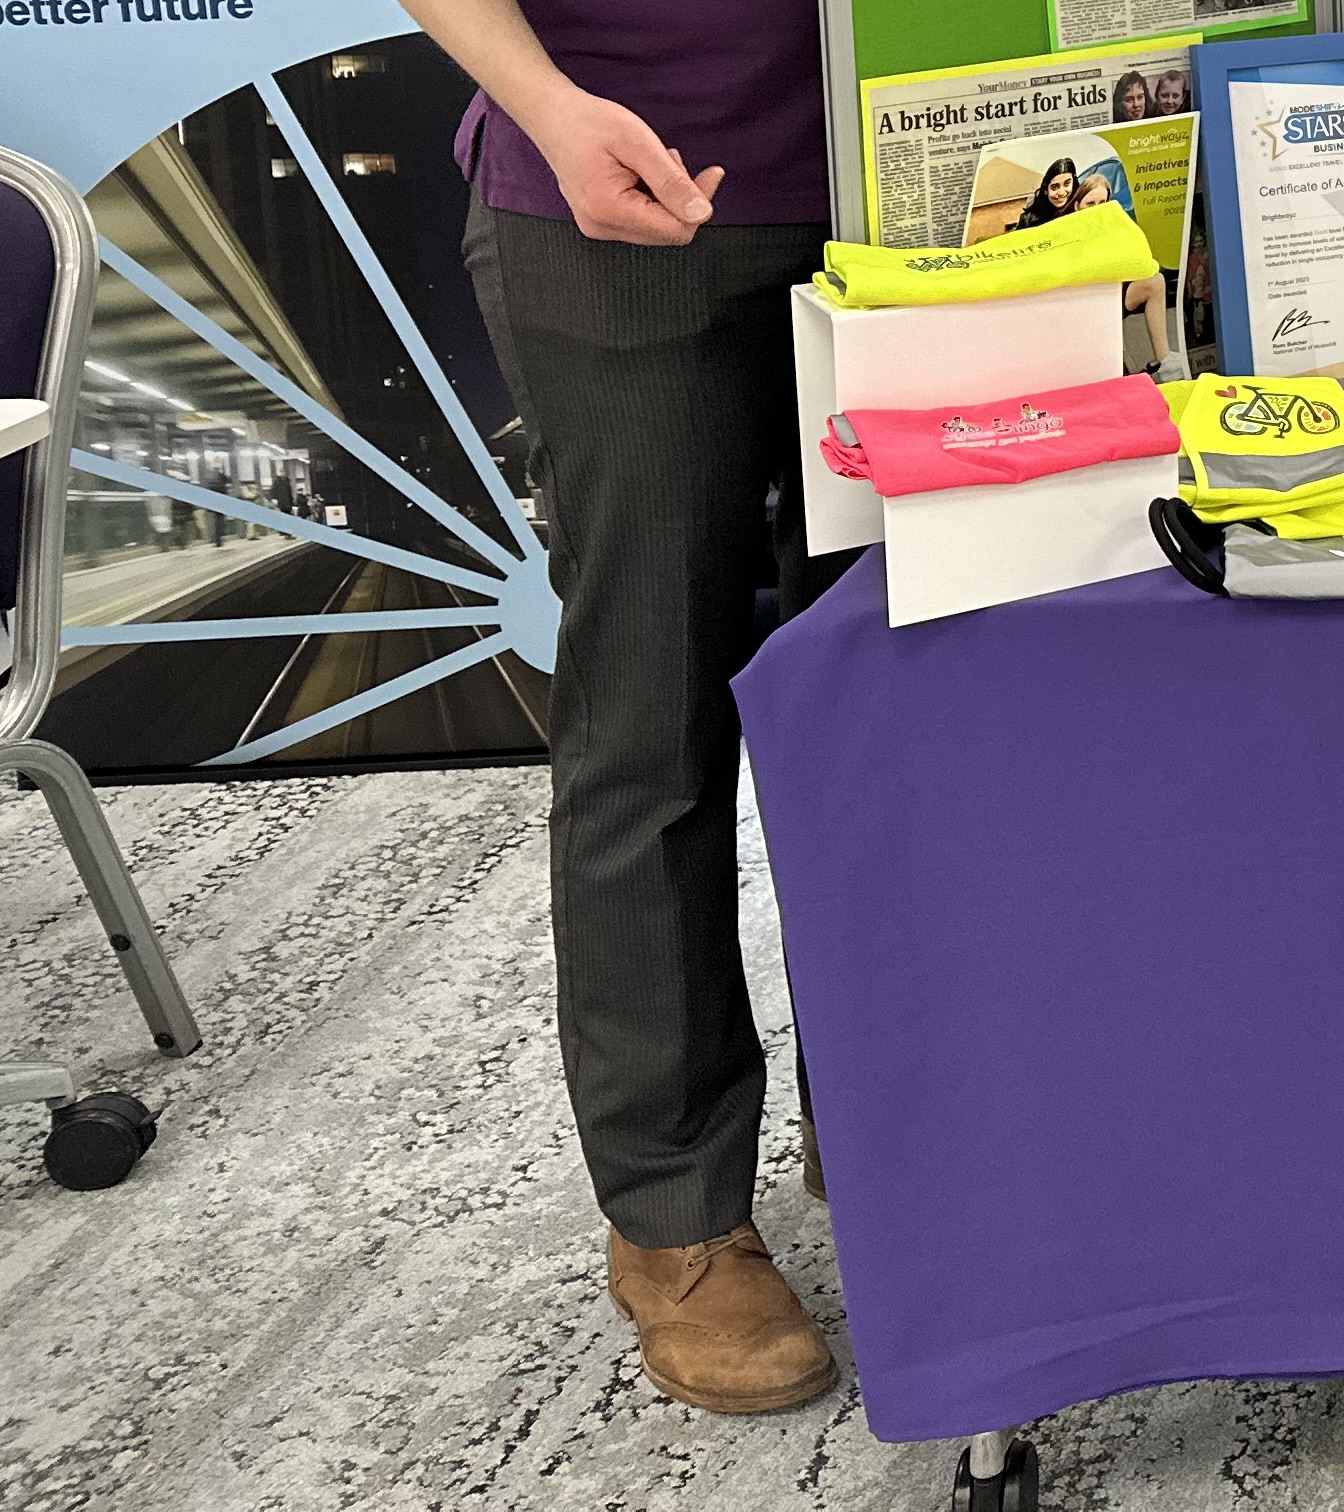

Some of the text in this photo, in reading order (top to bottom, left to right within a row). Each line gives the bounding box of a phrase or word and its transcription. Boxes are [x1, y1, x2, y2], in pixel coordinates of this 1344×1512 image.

[878, 85, 1107, 135] A bright start for kids
[1136, 158, 1189, 174] Initiatives
[1144, 176, 1187, 191] Impacts
[1259, 182, 1318, 197] Certificate
[1322, 179, 1332, 190] of
